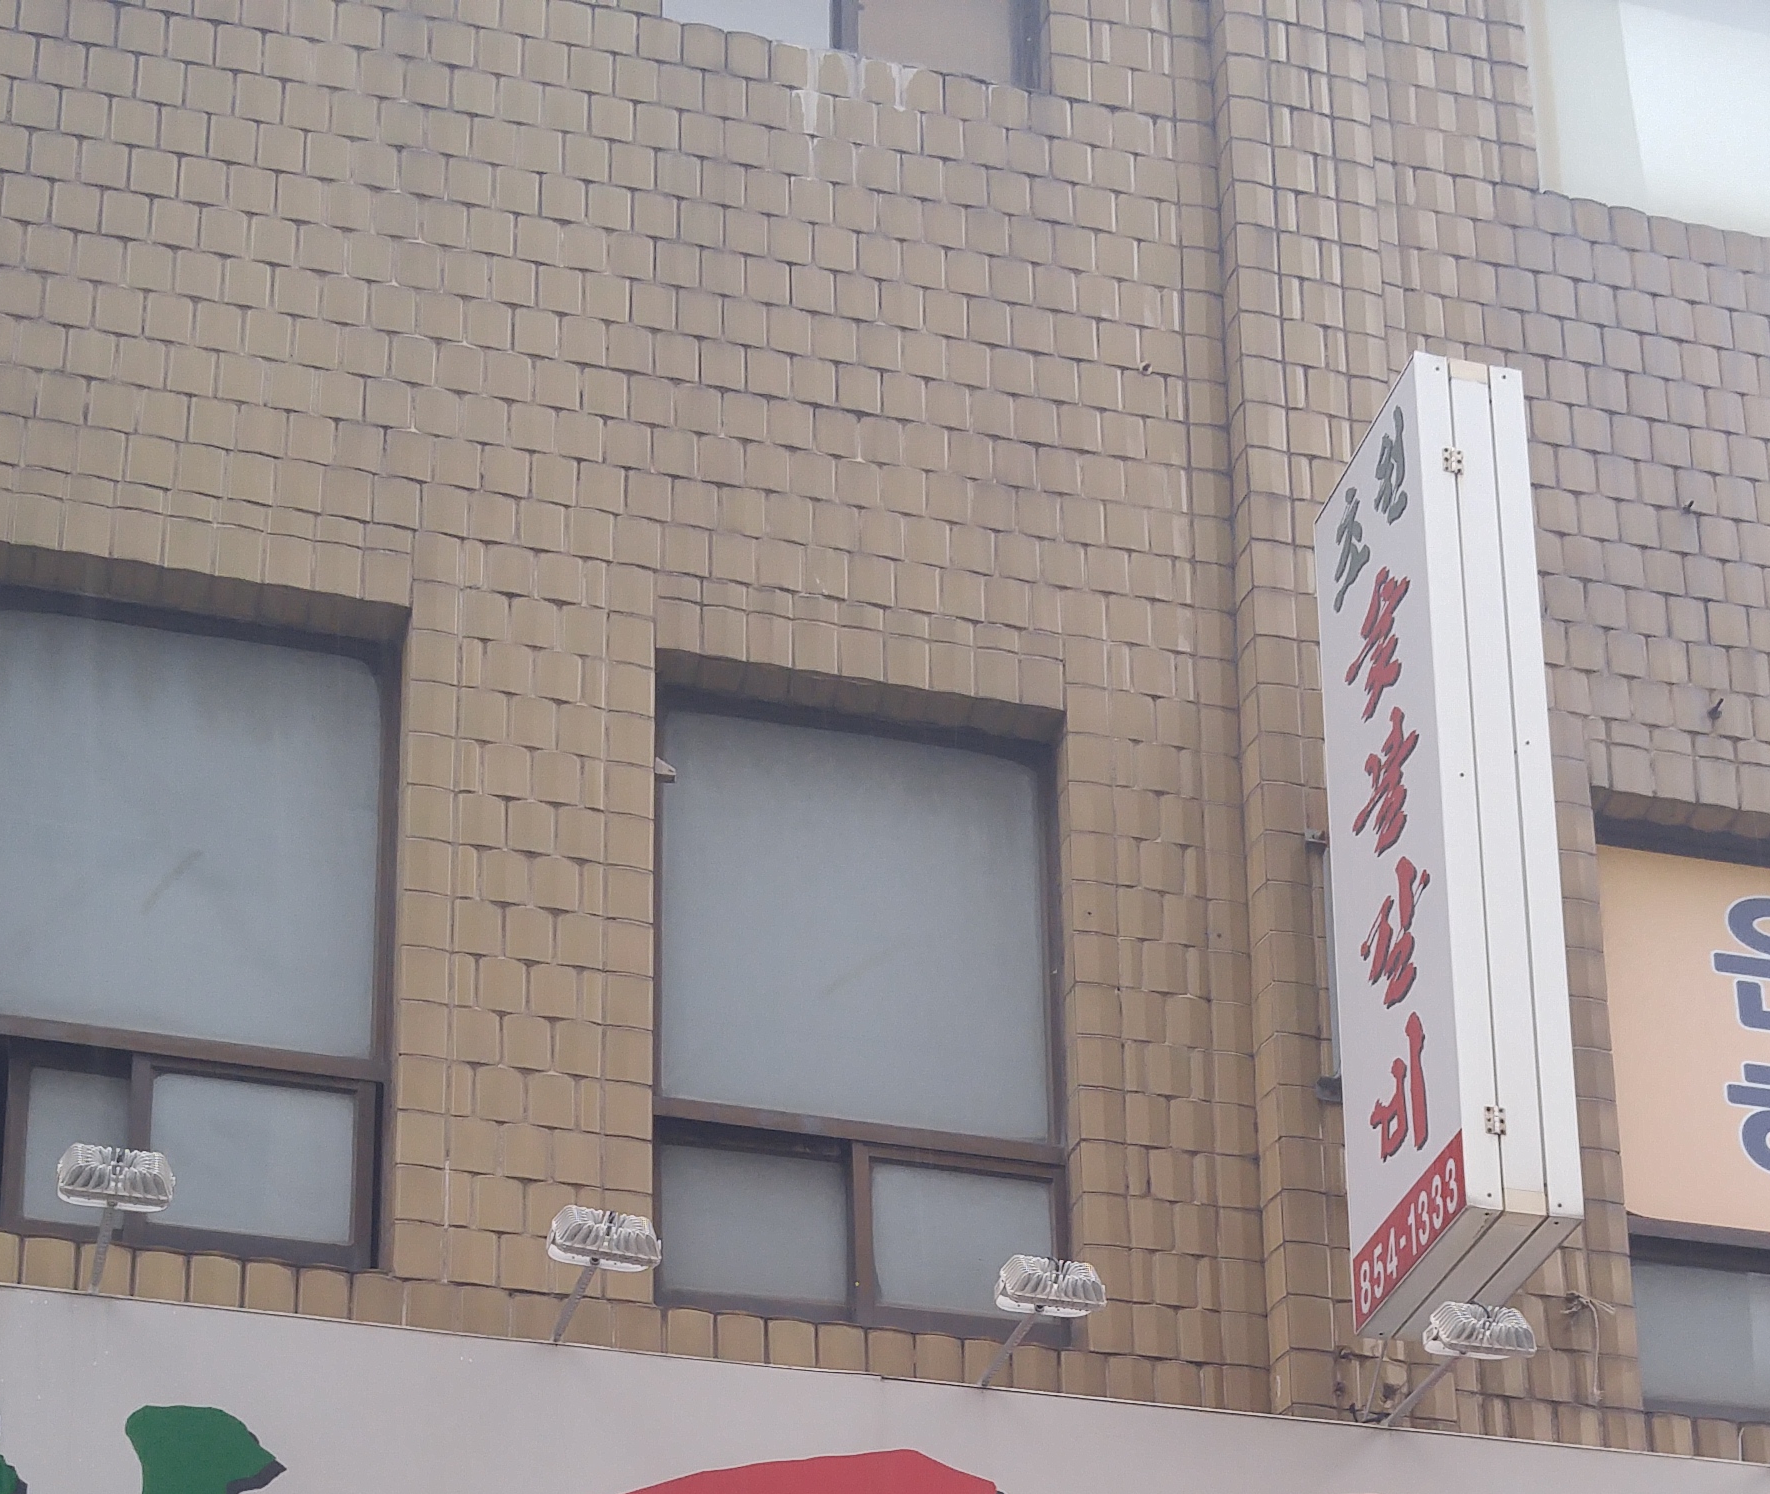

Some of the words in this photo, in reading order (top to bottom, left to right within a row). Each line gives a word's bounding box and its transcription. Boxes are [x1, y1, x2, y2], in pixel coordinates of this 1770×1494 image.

[1335, 404, 1409, 614] 초원
[1346, 565, 1431, 1163] 숯불갈비
[1359, 1157, 1459, 1314] 854-1333
